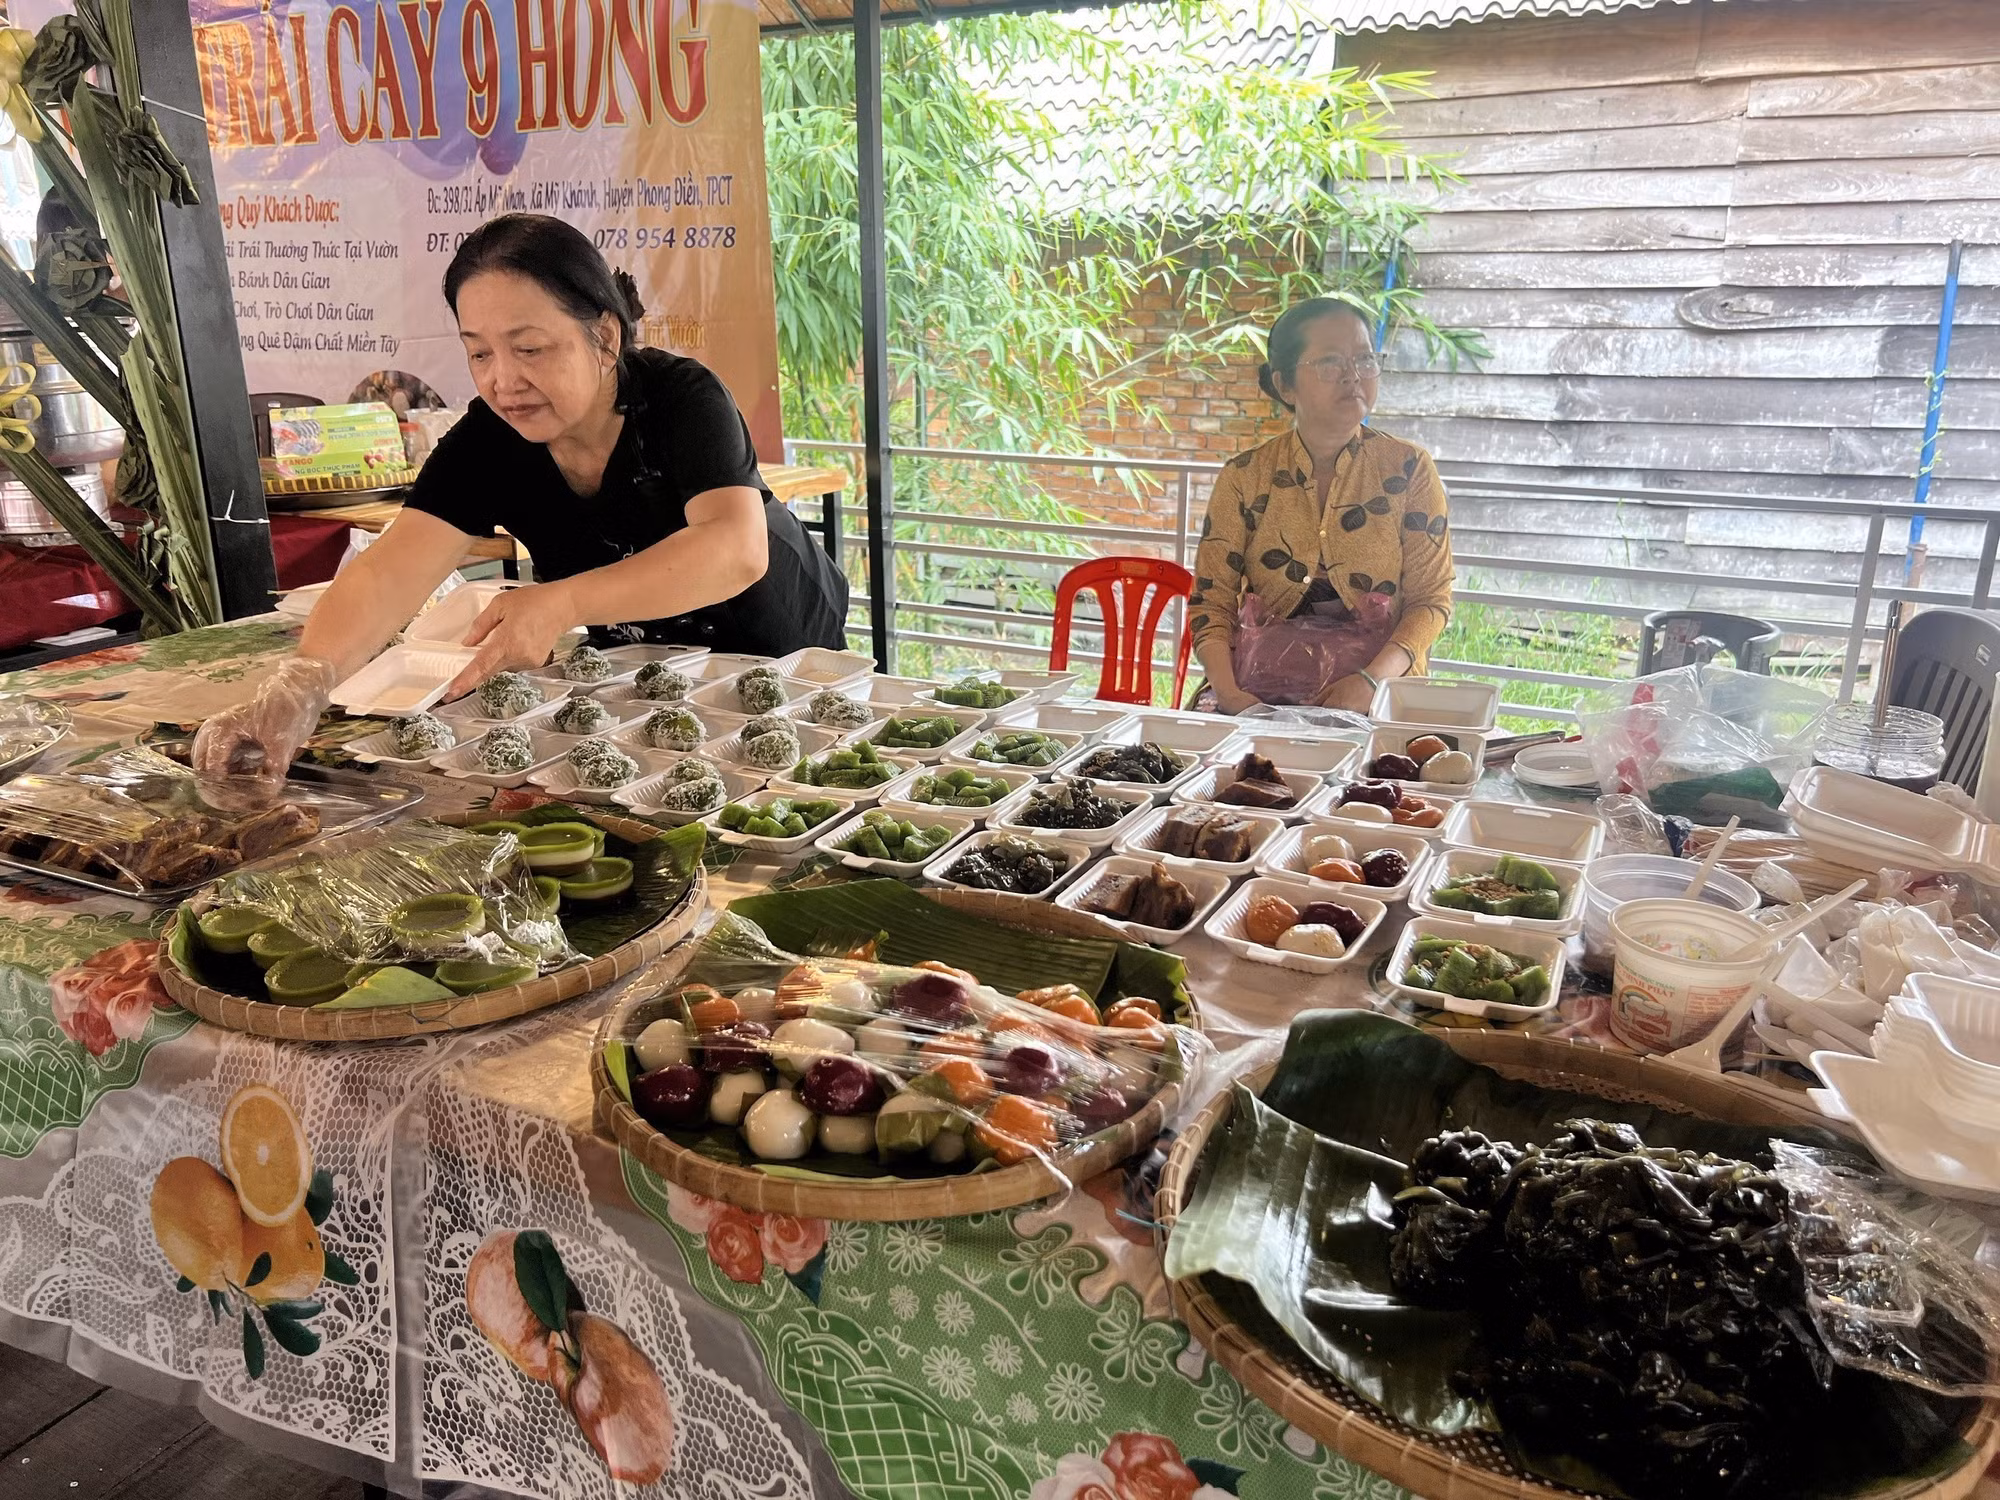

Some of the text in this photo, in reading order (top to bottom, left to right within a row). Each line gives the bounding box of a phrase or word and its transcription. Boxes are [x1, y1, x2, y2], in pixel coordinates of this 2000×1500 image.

[461, 0, 500, 139] 9
[443, 186, 472, 215] 398/31
[545, 181, 560, 215] Mỹ
[562, 180, 600, 213] Khánh,
[603, 176, 634, 214] Huyện
[637, 177, 671, 213] Phong
[675, 170, 702, 210] Điền,
[707, 175, 732, 206] TPCT
[219, 194, 339, 229] ng Quý Khách Được:
[239, 241, 260, 258] Trái
[265, 240, 308, 263] Thưởng
[312, 241, 341, 258] Thức
[344, 240, 362, 262] Tại
[366, 240, 399, 259] Vườn
[426, 233, 449, 252] ĐT:
[594, 228, 628, 250] 078
[636, 227, 675, 249] 954
[684, 227, 736, 248] 8878
[238, 271, 269, 288] Bánh
[273, 271, 298, 288] Dân
[302, 272, 330, 289] Gian
[264, 301, 282, 319] Trò
[286, 302, 313, 319] Chơi
[317, 302, 342, 320] Dân
[346, 303, 374, 321] Gian
[241, 331, 400, 357] ng Quê Đậm Chất Miền Tây
